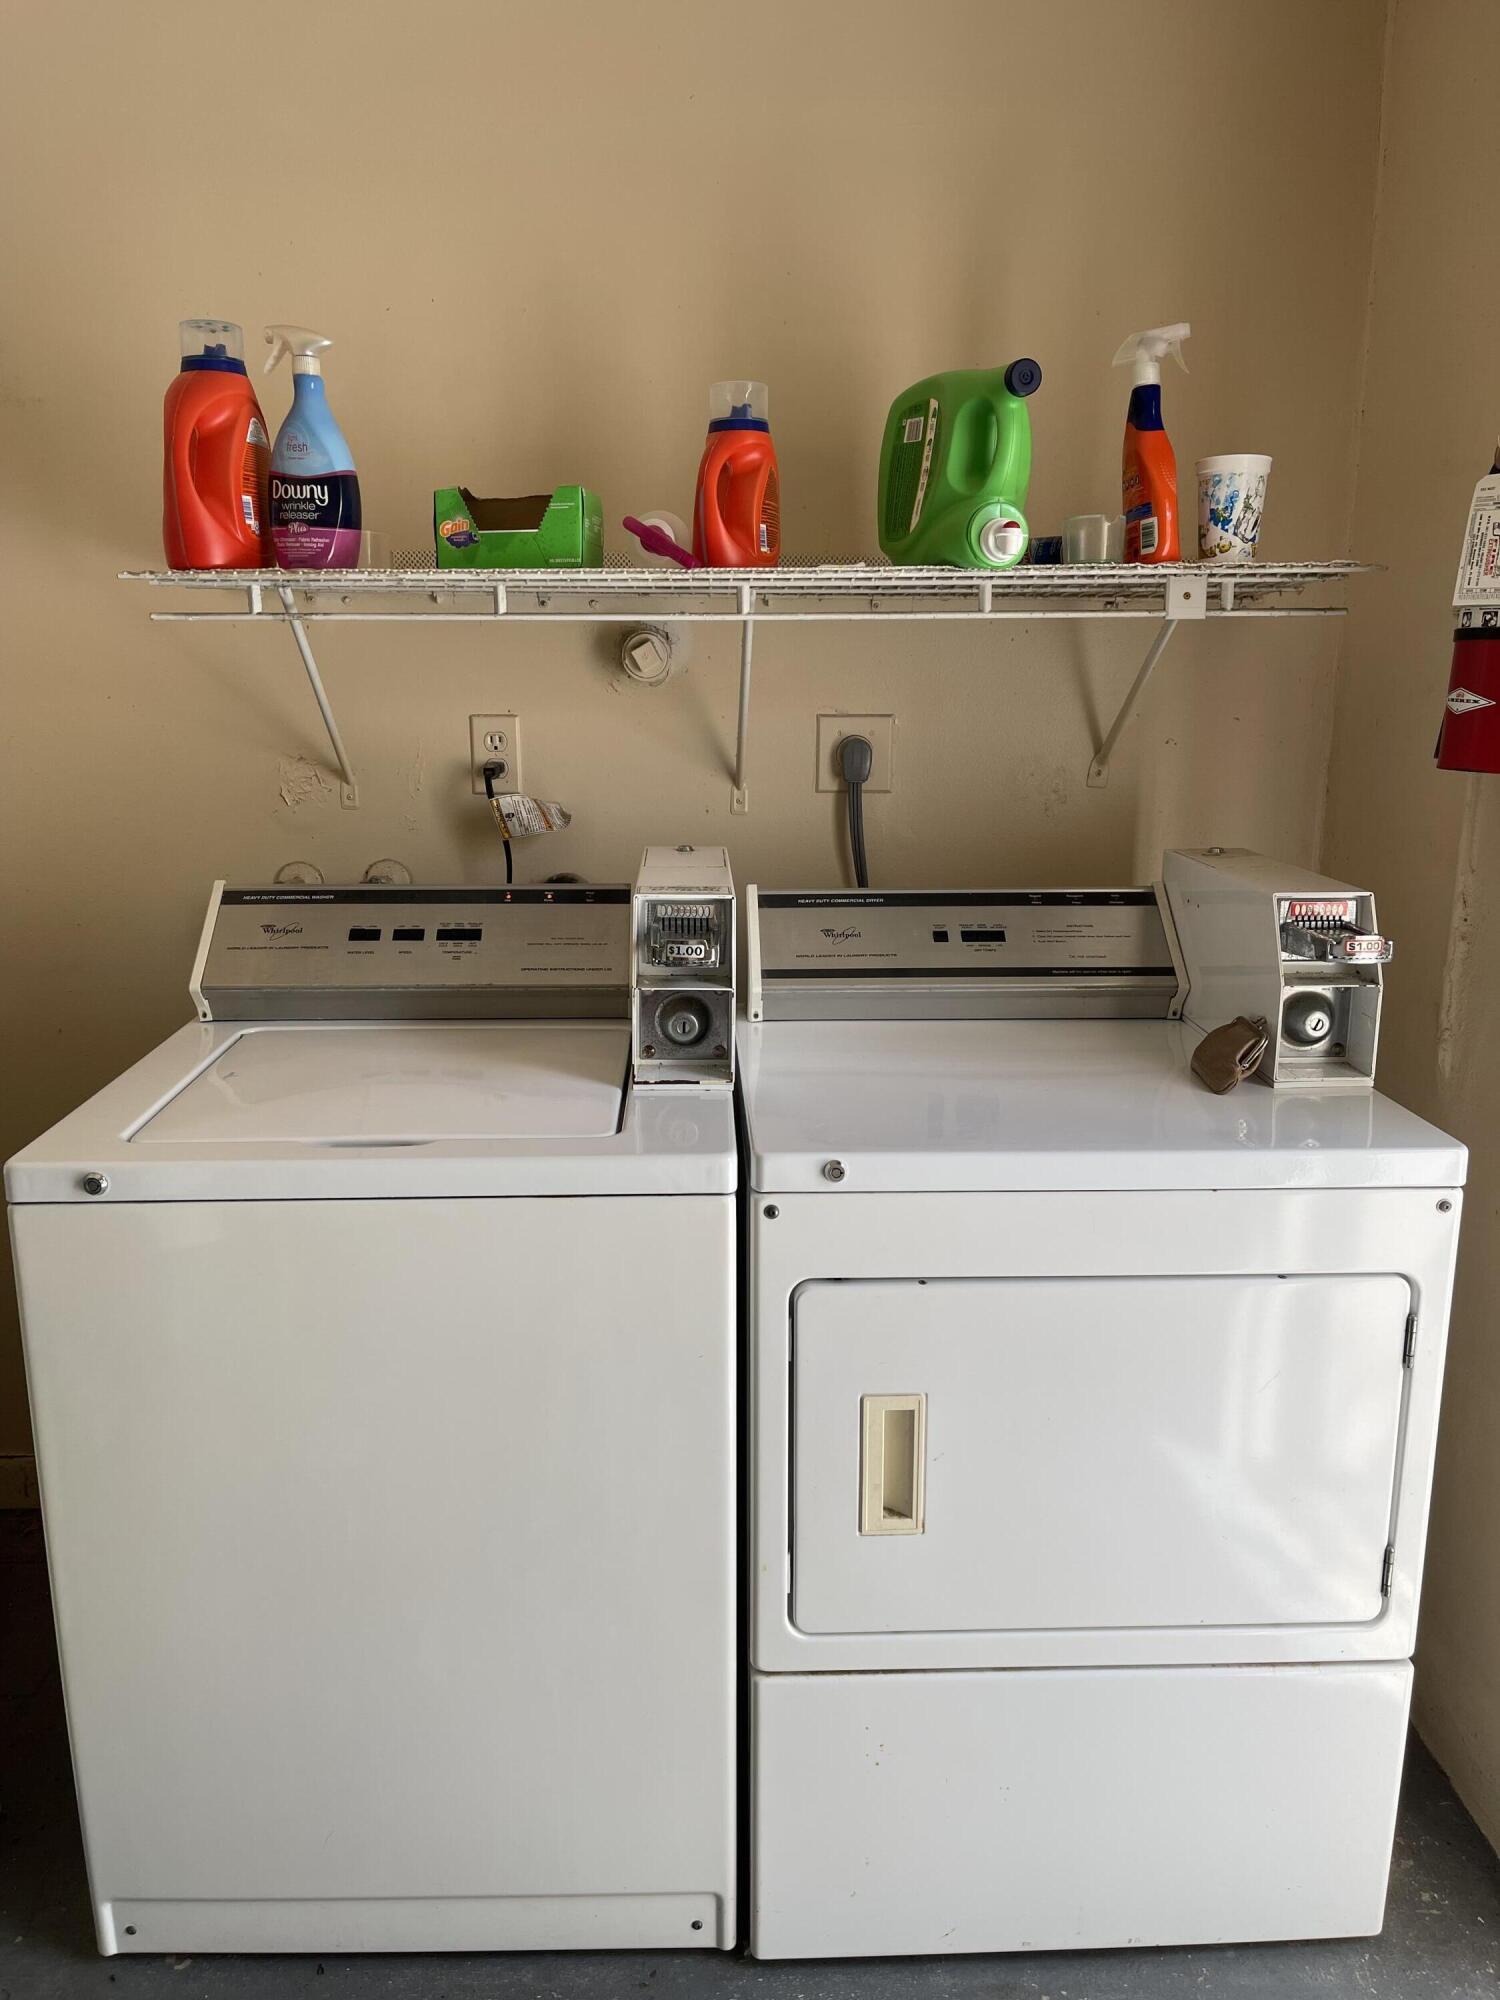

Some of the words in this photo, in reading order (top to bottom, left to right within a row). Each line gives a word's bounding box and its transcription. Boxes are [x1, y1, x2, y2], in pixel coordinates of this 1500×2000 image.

[287, 440, 308, 452] fresh
[272, 479, 329, 507] Downy
[281, 501, 316, 511] wrinkle
[280, 510, 320, 520] releaser
[288, 521, 307, 534] Plus
[440, 517, 470, 538] Gain
[262, 925, 303, 937] Whirlpool
[822, 930, 862, 941] Whirlpool
[668, 945, 703, 957] $1.00
